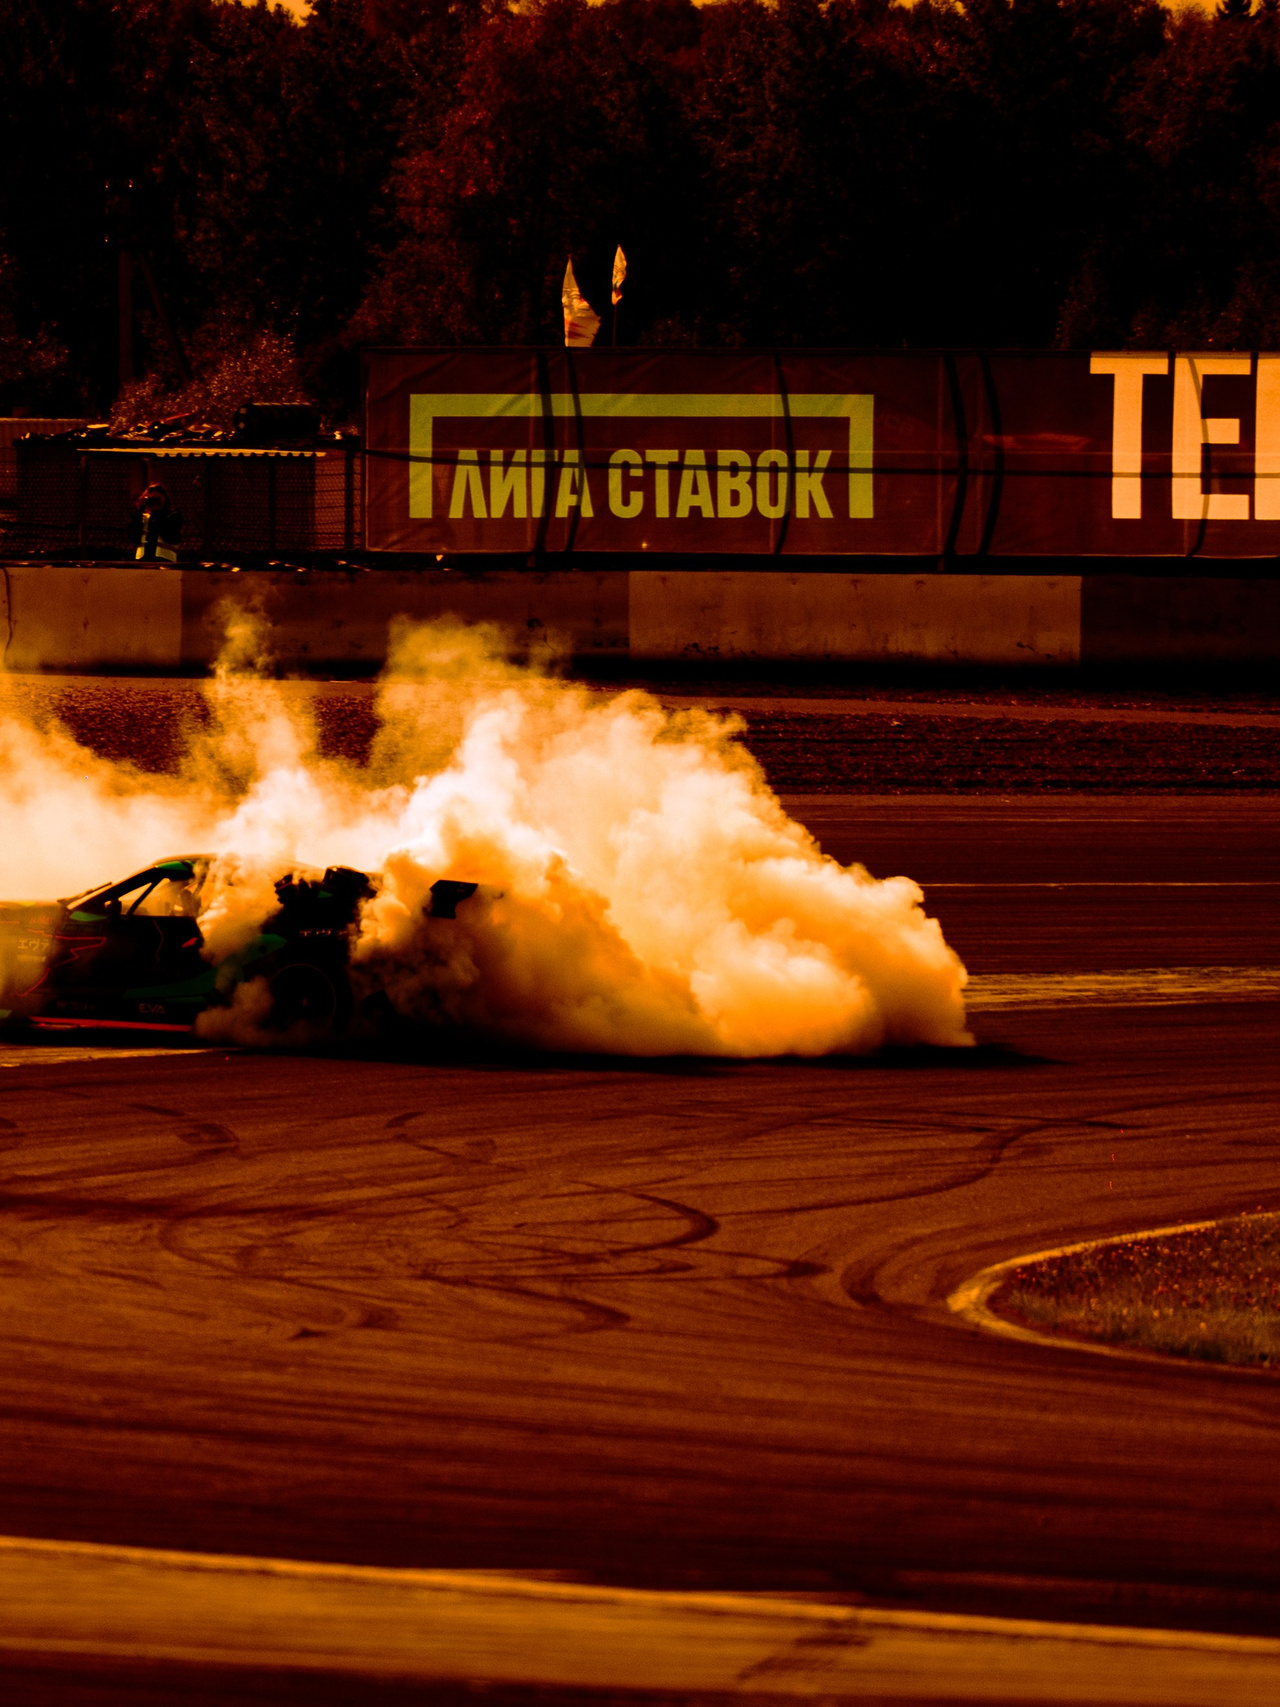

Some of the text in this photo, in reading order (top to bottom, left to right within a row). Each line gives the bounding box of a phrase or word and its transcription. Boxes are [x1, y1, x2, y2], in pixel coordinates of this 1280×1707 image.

[449, 448, 834, 519] ЛИГА СТАВОК
[138, 1003, 167, 1015] EVA
